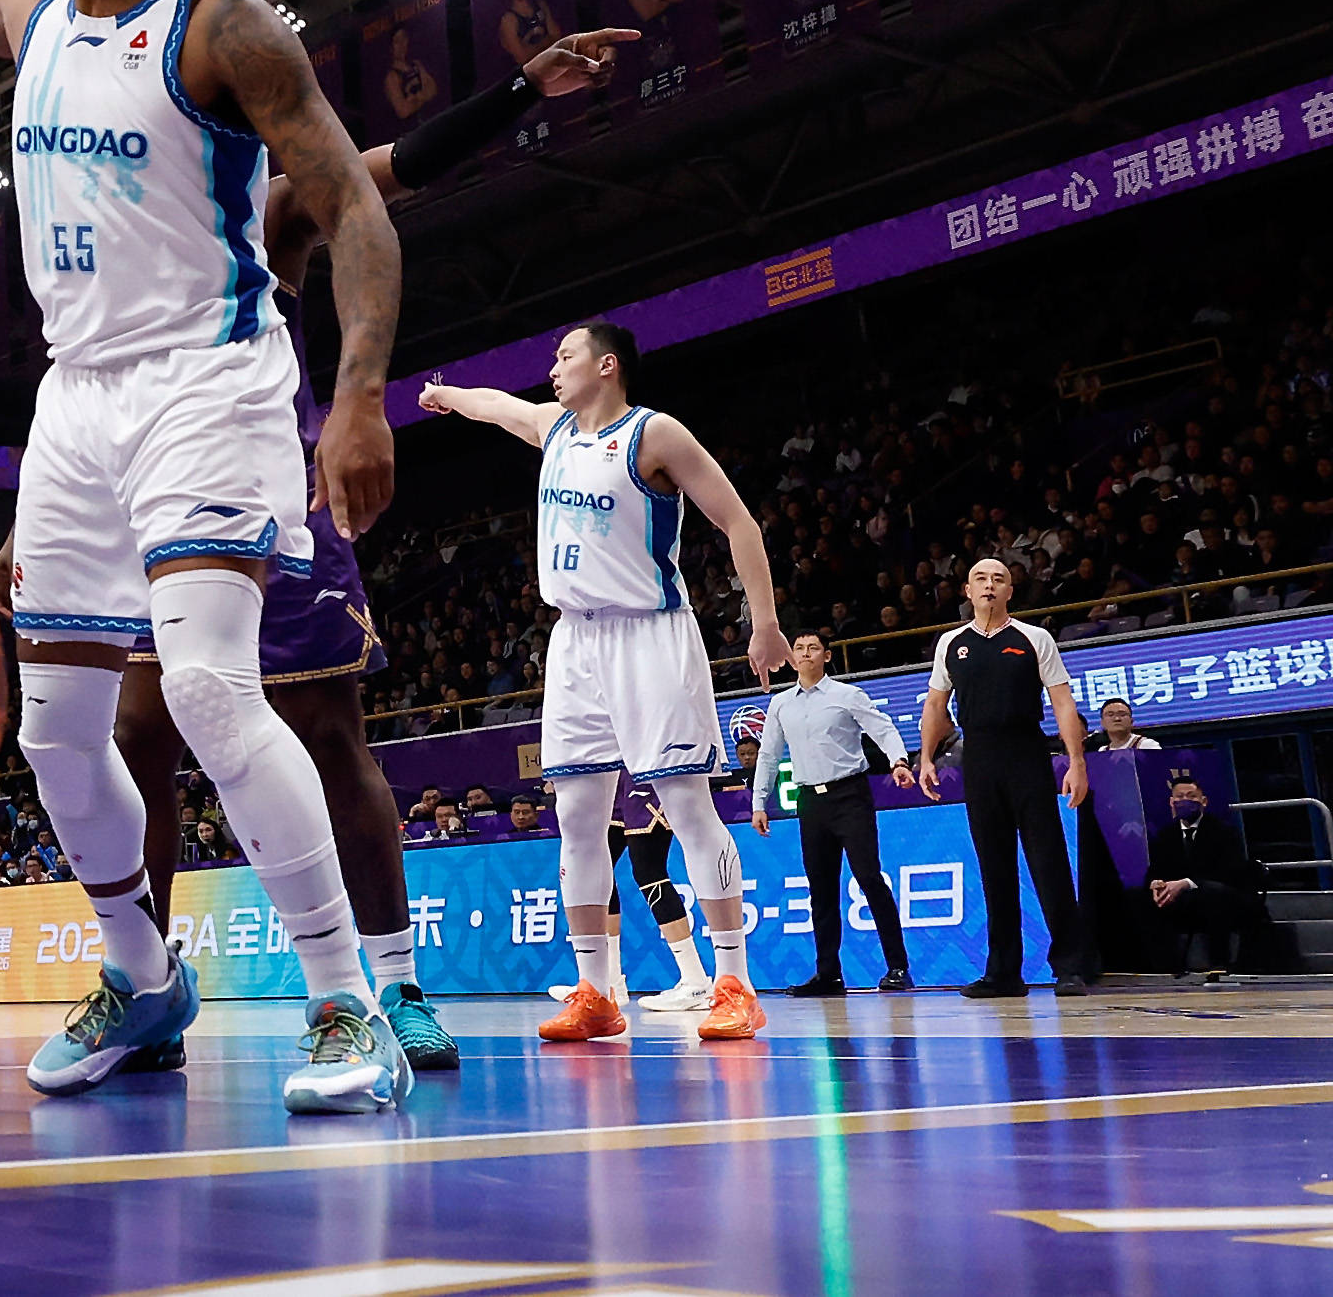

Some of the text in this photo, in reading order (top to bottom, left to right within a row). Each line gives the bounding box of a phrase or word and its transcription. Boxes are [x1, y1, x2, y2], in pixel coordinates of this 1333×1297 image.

[123, 62, 139, 70] CGB
[16, 125, 148, 159] QINGDAO
[946, 171, 1099, 250] 团结一心
[1113, 107, 1285, 199] 顽强拼搏
[53, 225, 95, 272] 55
[766, 258, 832, 295] BG北控
[540, 488, 615, 511] INGDAO
[553, 543, 581, 571] 16
[1046, 639, 1333, 712] 中国男子篮球
[36, 921, 104, 964] 202
